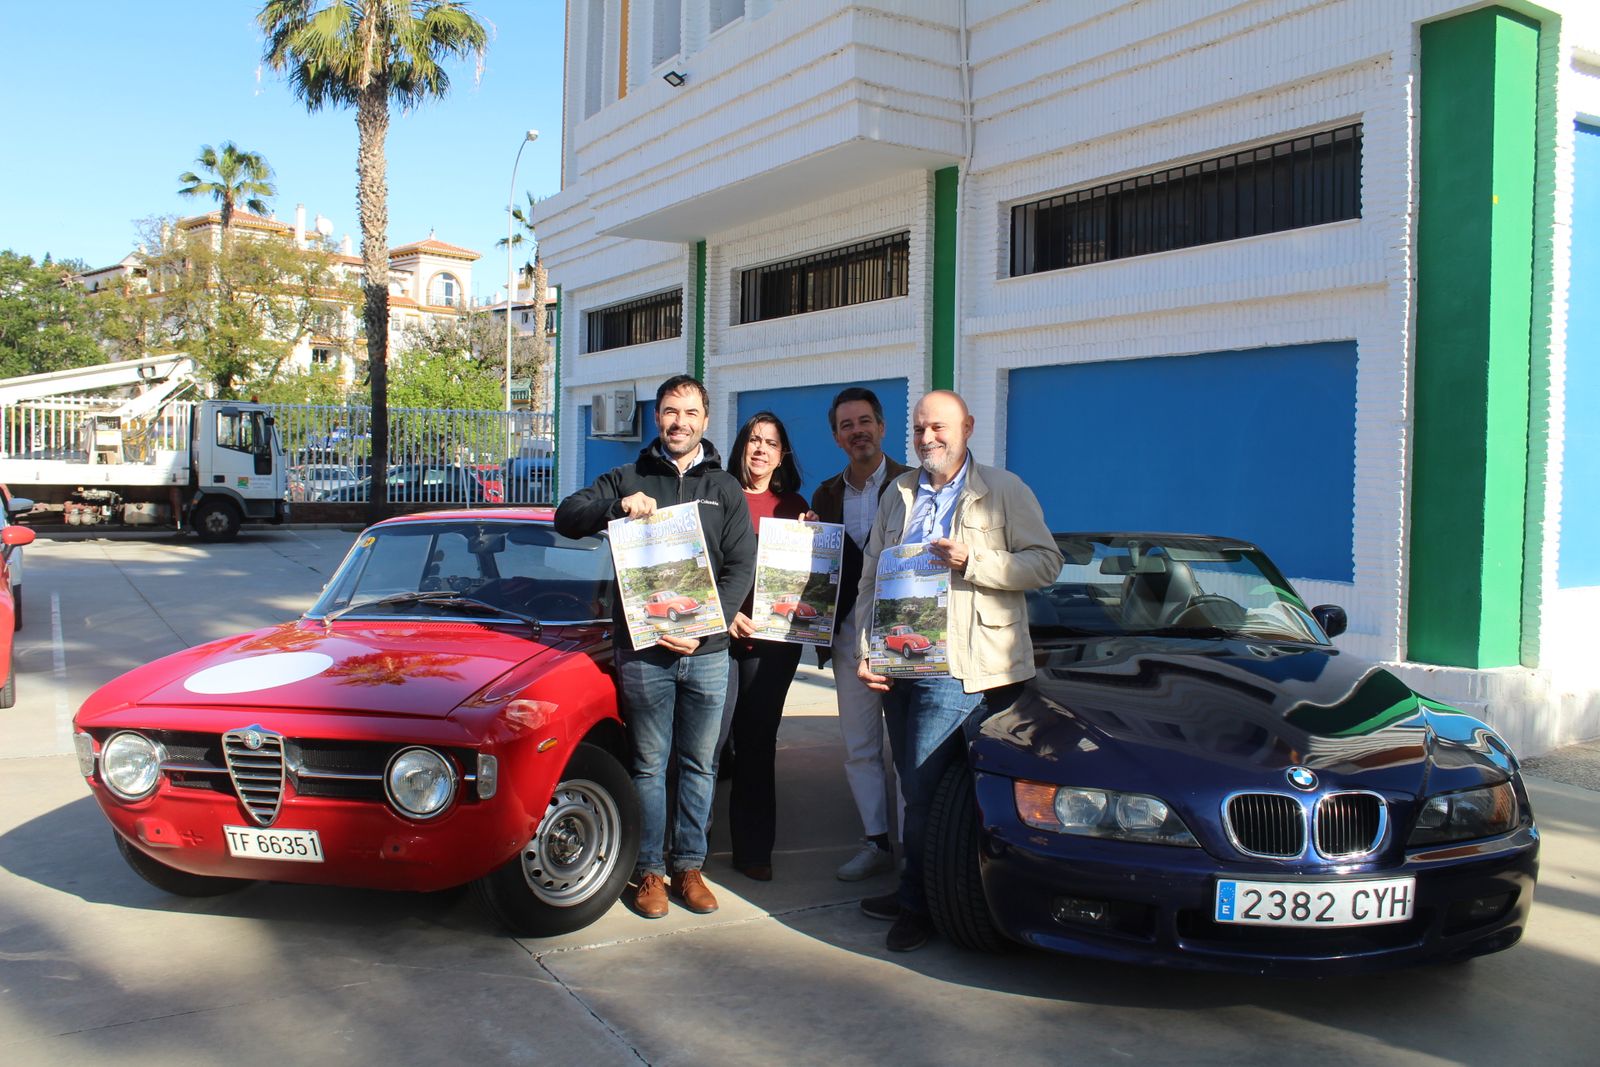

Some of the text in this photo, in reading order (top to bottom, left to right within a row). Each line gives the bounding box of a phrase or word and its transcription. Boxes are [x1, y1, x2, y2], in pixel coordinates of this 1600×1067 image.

[650, 508, 697, 538] COMARES
[228, 832, 318, 856] TF 66351
[1222, 905, 1230, 914] E
[1242, 886, 1408, 922] 2382 CYH
